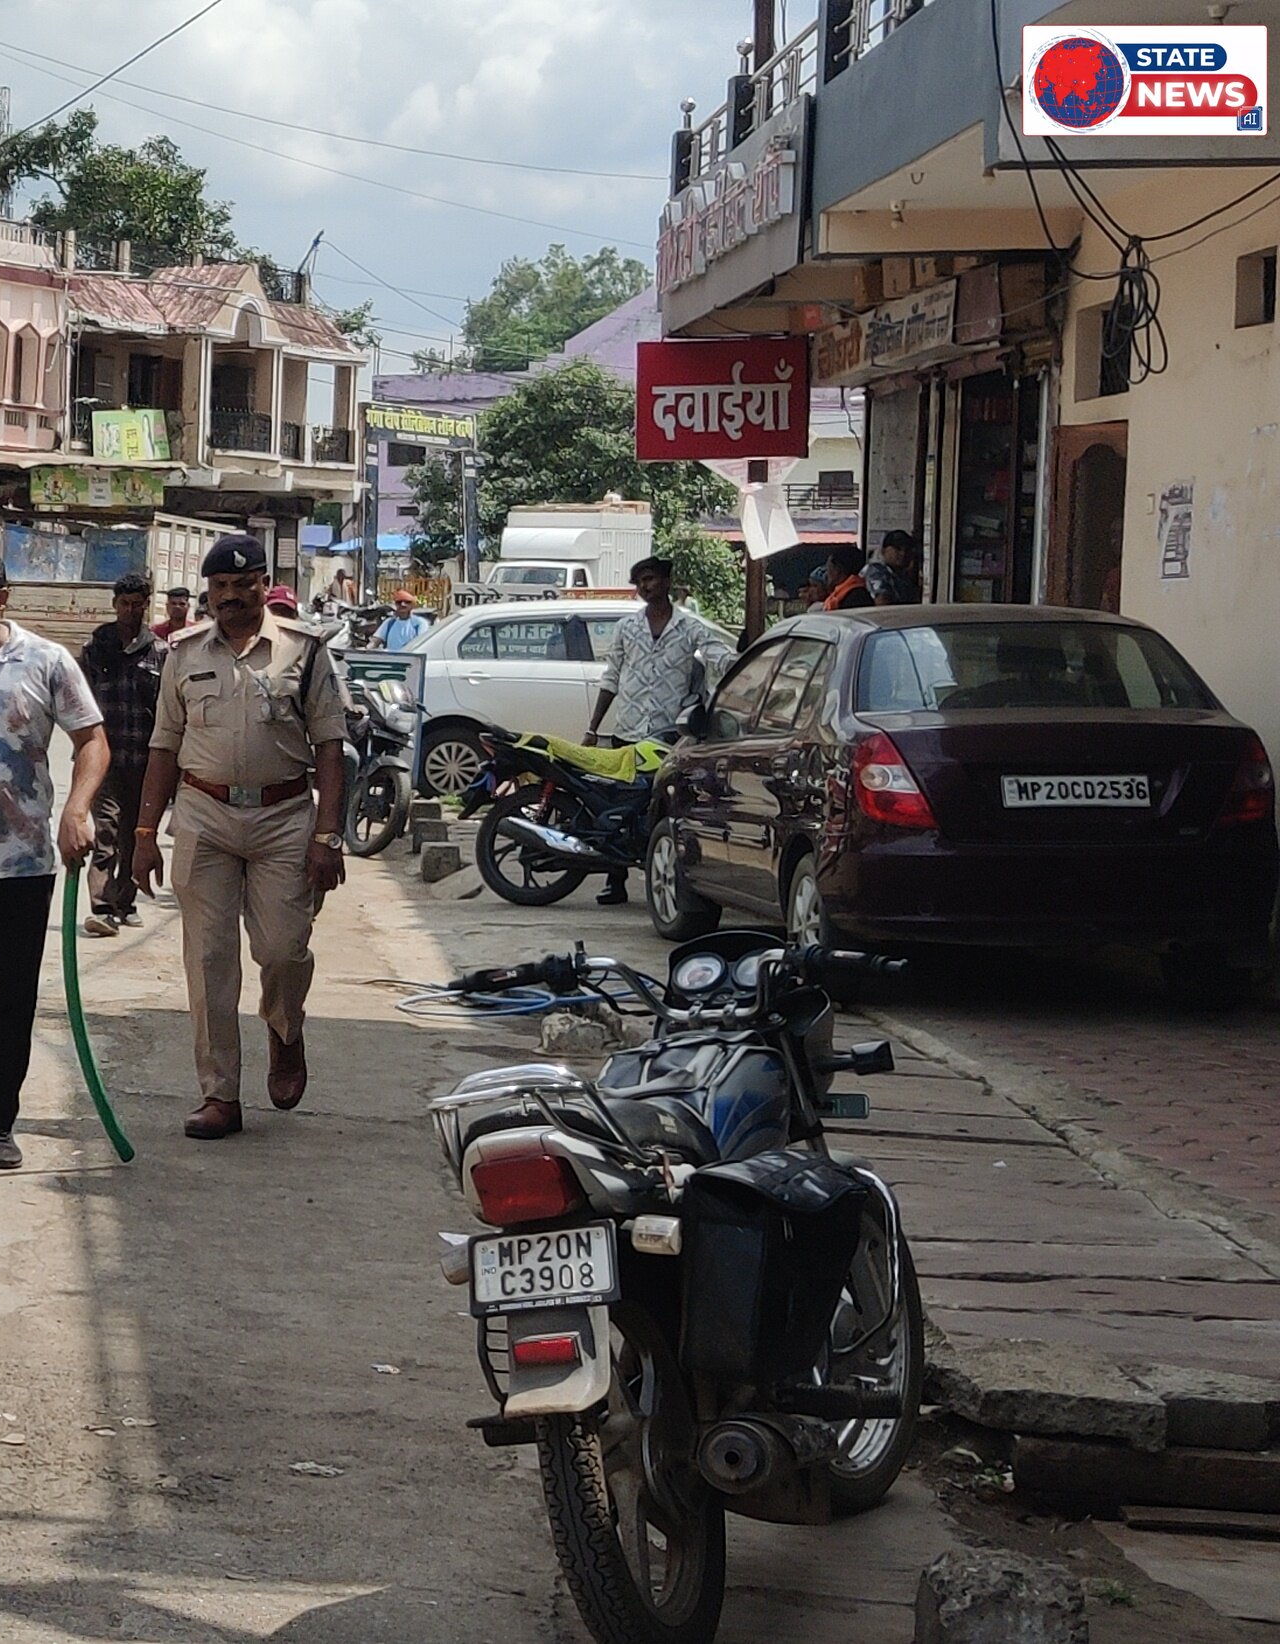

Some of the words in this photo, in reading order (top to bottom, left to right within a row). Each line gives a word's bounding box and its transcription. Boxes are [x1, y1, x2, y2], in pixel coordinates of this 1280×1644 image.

[651, 357, 794, 441] दवाईयाँ
[1017, 780, 1148, 801] MP20CD2536
[498, 1230, 592, 1268] MP20N
[500, 1261, 594, 1296] C3908
